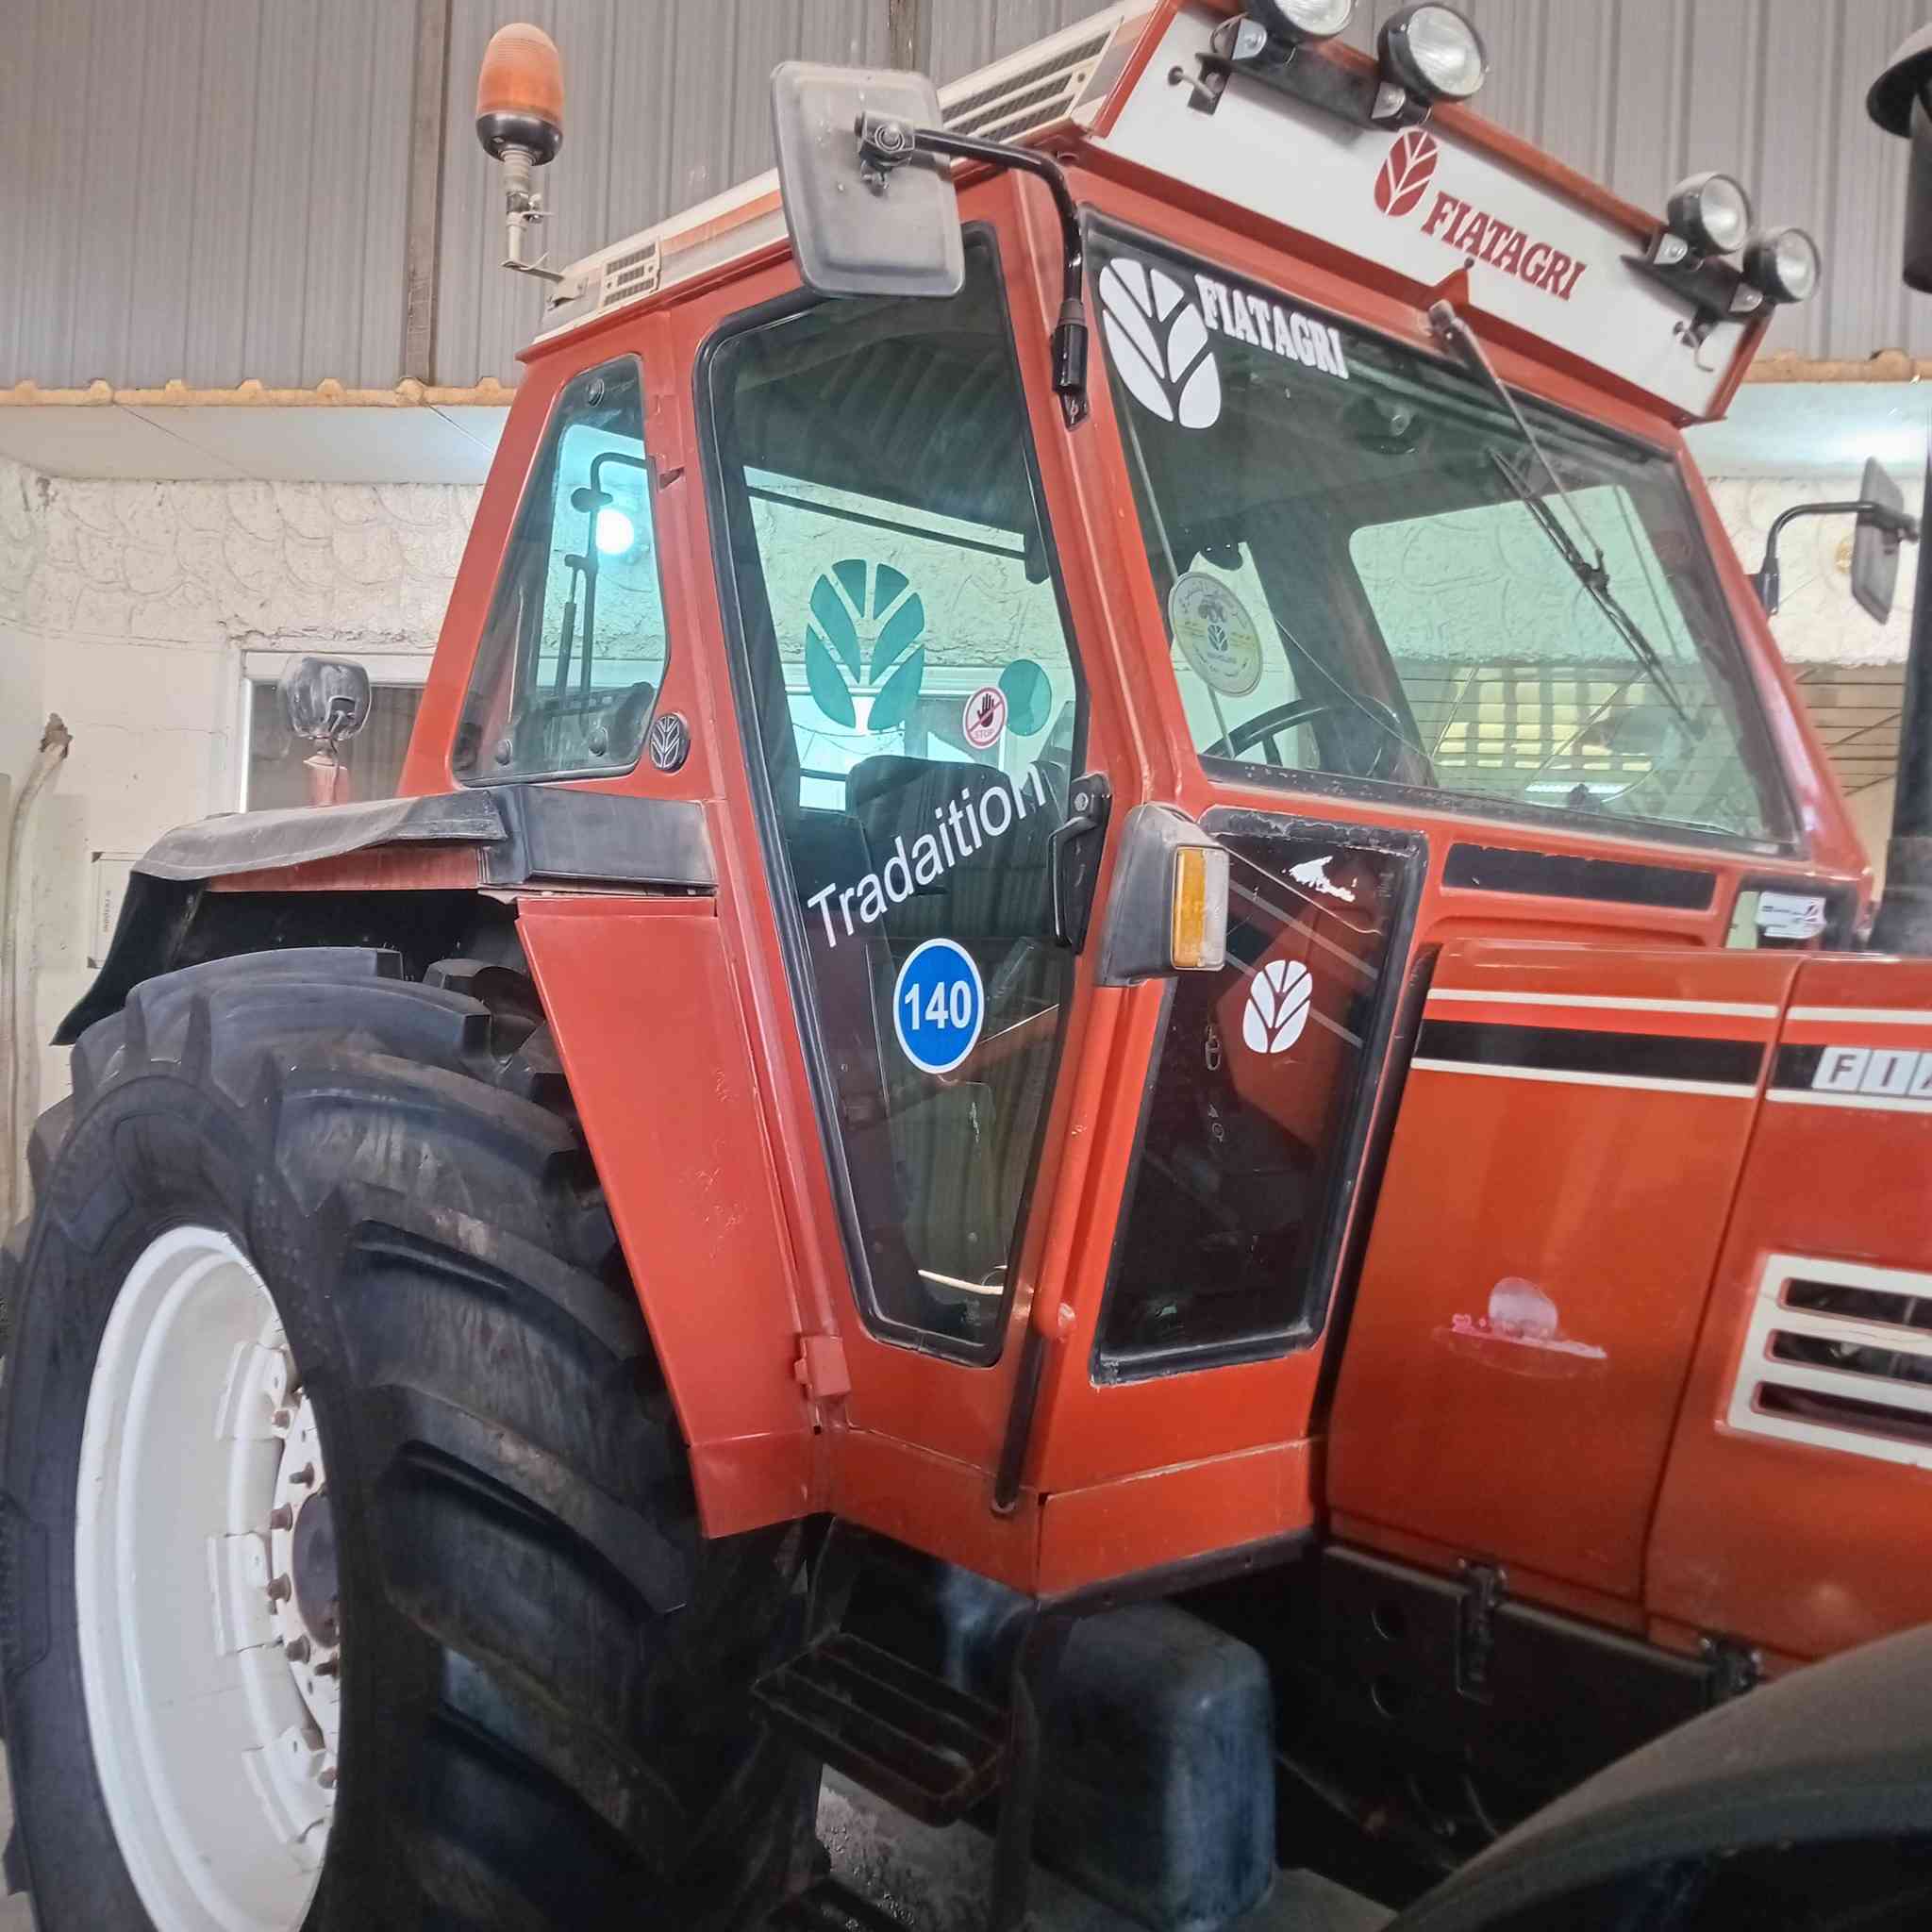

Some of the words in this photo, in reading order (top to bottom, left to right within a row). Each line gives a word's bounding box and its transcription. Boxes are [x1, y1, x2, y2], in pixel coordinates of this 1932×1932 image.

[1420, 191, 1587, 301] FIATAGRI
[1194, 274, 1349, 379] FIATAGRI
[807, 763, 1047, 948] Tradaition
[904, 980, 972, 1031] 140
[1827, 1054, 1932, 1091] FI
